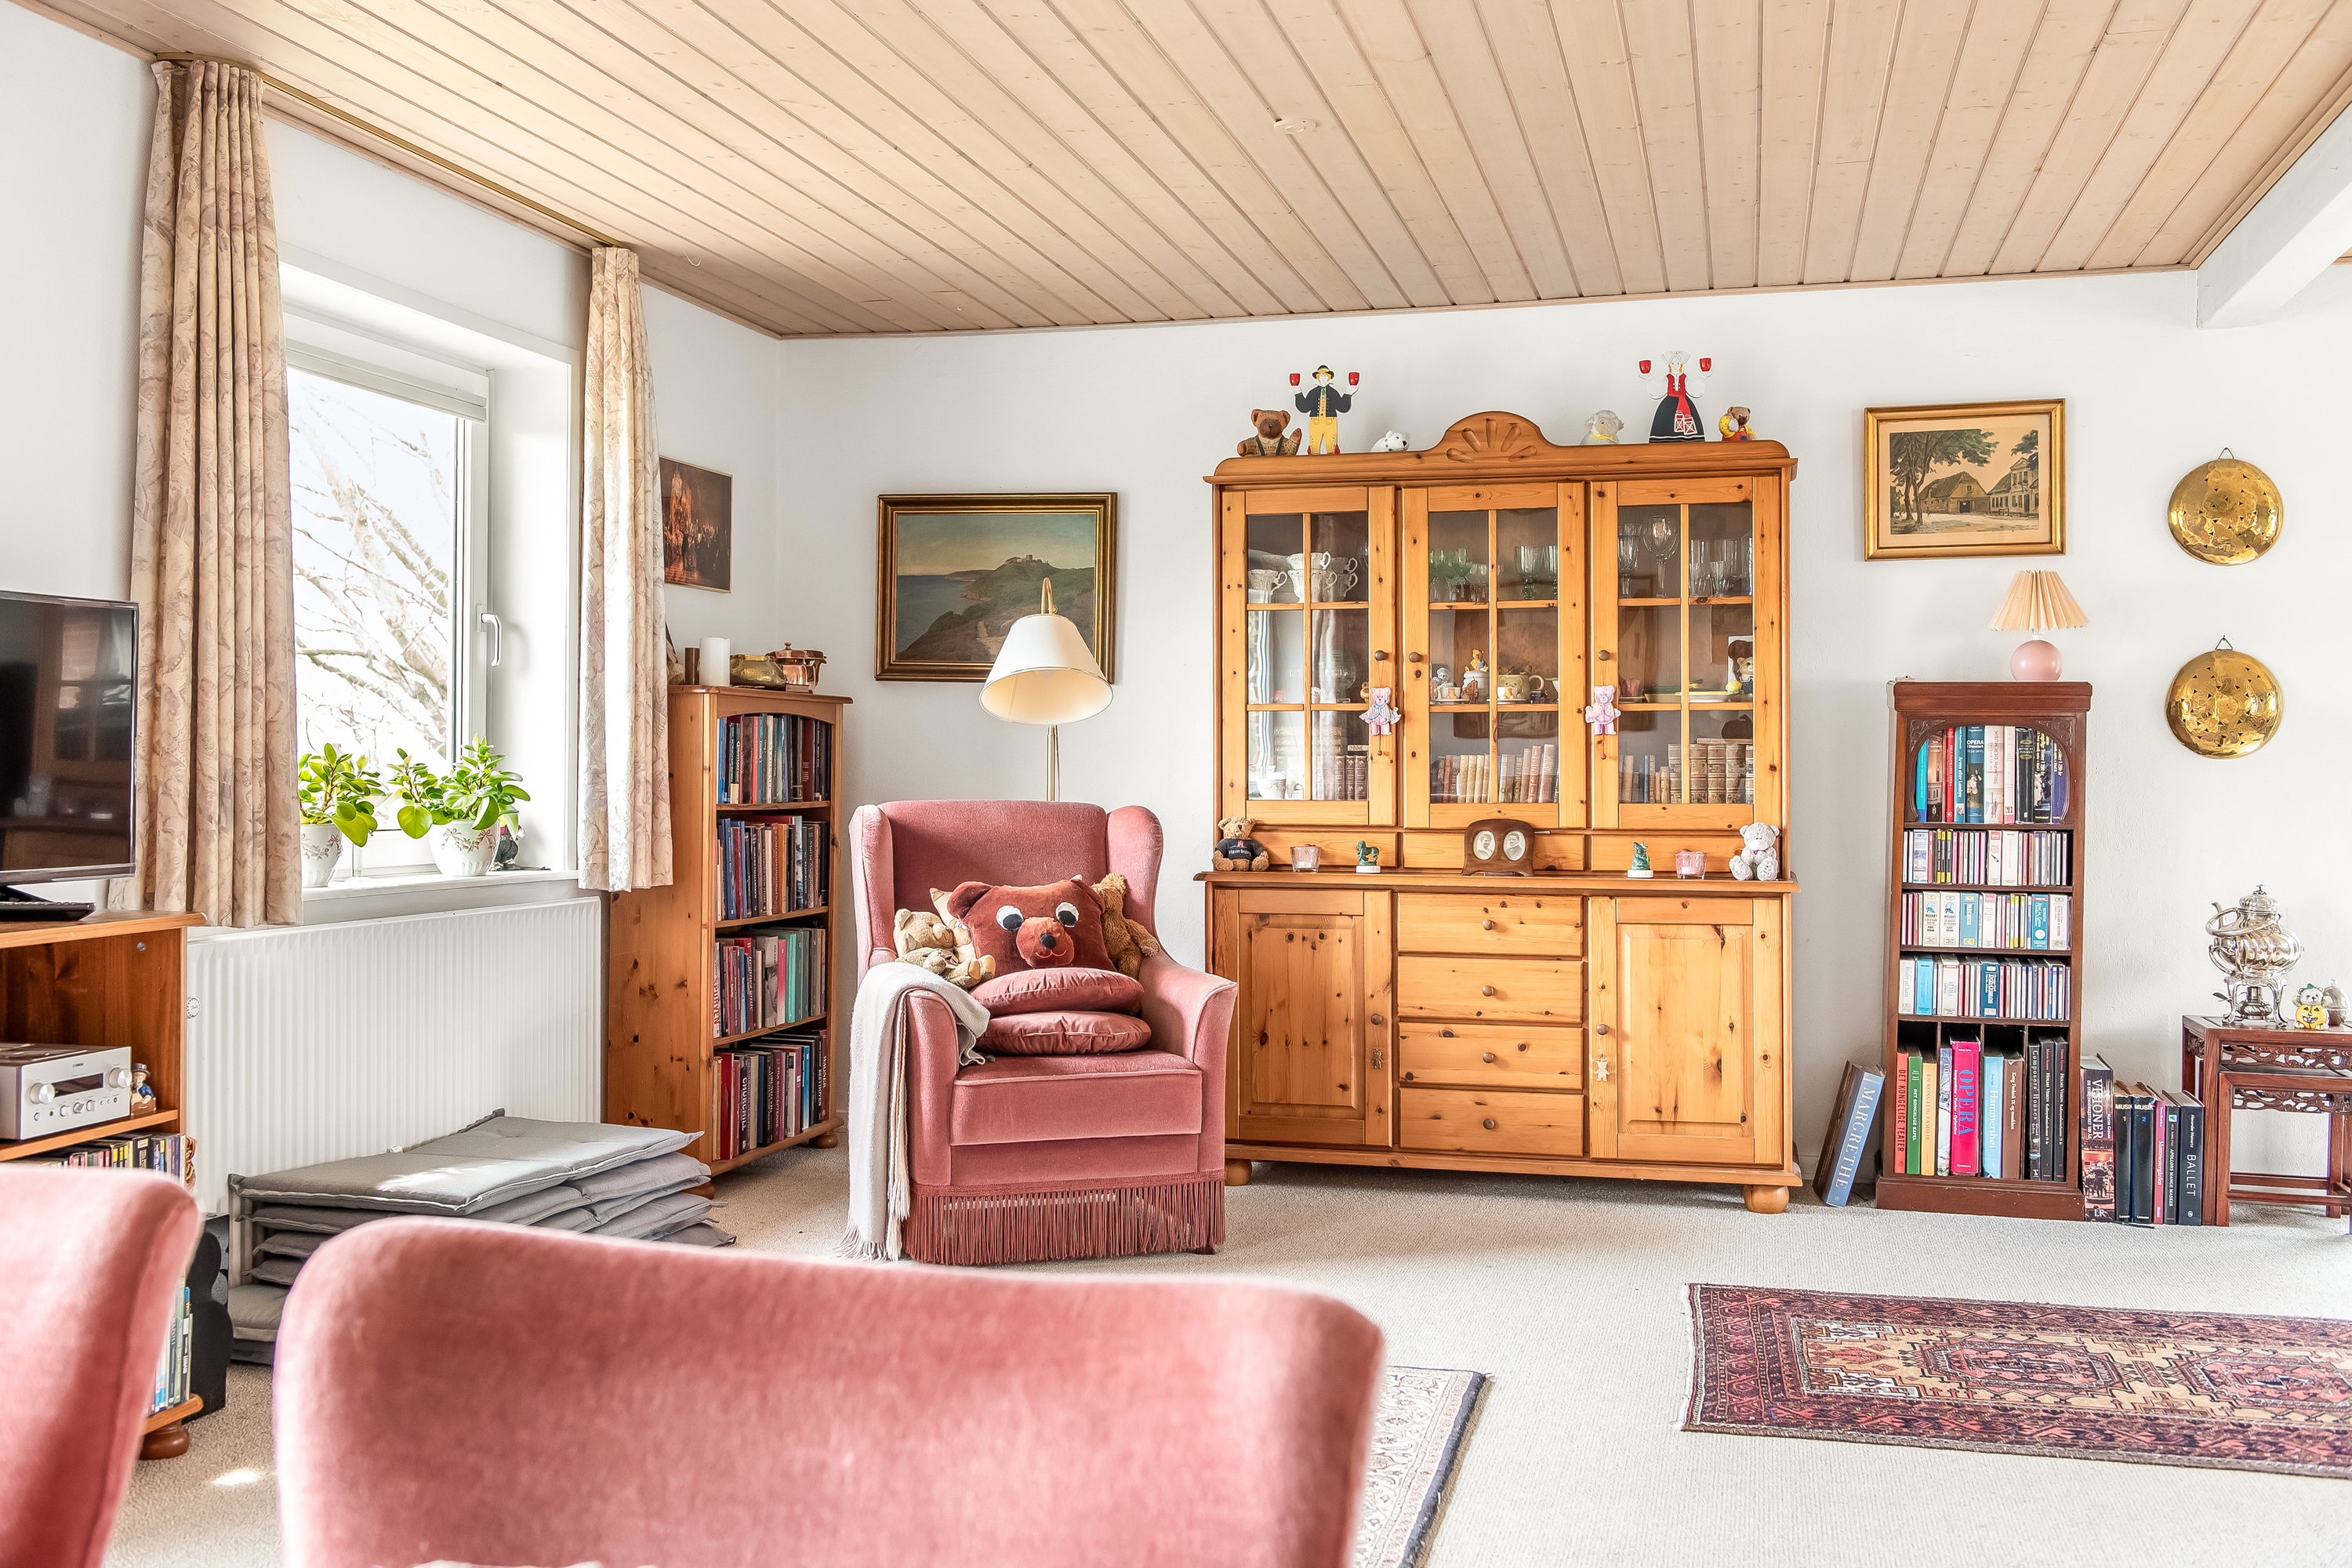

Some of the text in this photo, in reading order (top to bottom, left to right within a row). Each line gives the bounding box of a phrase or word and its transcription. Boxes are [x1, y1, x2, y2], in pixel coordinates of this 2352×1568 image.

[1958, 1069, 1975, 1135] OPERA
[1989, 1090, 1998, 1148] Hammershøi
[2092, 1079, 2103, 1140] VISIONER
[1835, 1086, 1876, 1190] MARGRETHE
[2187, 1155, 2197, 1196] BALLET
